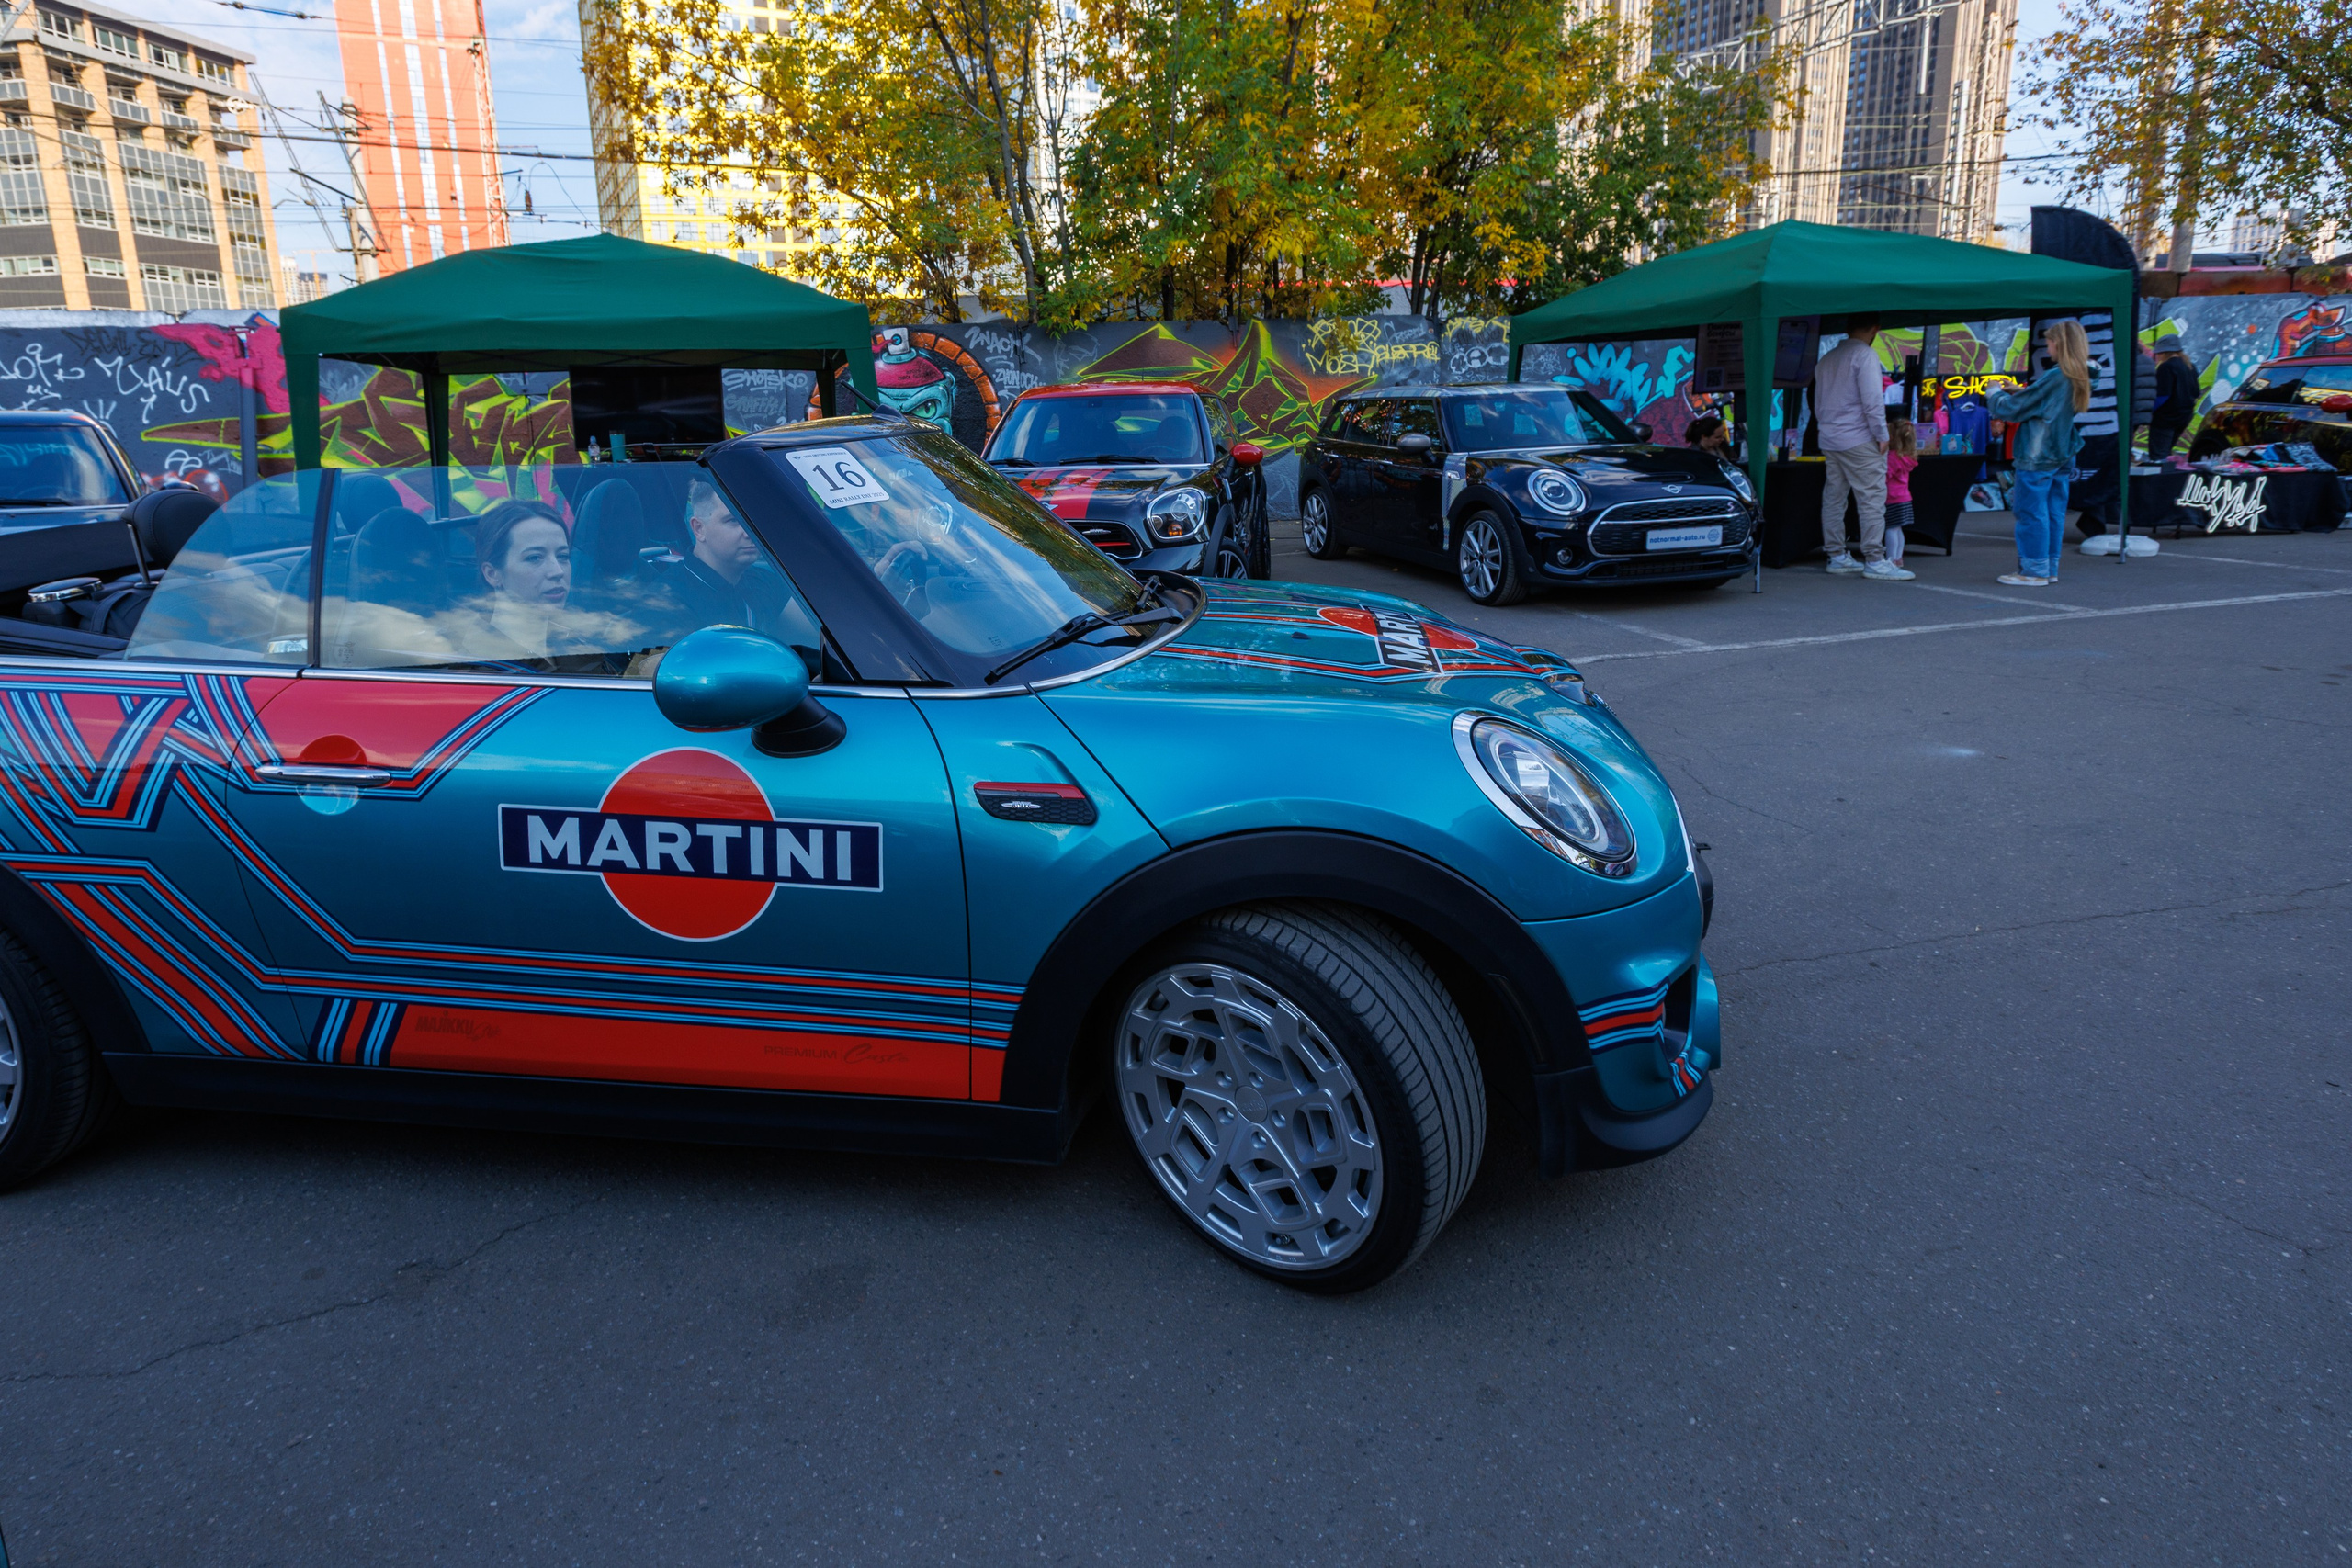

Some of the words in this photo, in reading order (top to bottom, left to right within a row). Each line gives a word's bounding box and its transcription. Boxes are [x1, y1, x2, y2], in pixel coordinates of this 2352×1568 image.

[812, 461, 866, 491] 16
[829, 497, 843, 505] MINI
[1649, 535, 1706, 544] notnormal-auto.ru
[526, 814, 852, 882] MARTINI
[763, 1044, 837, 1059] PREMIUM
